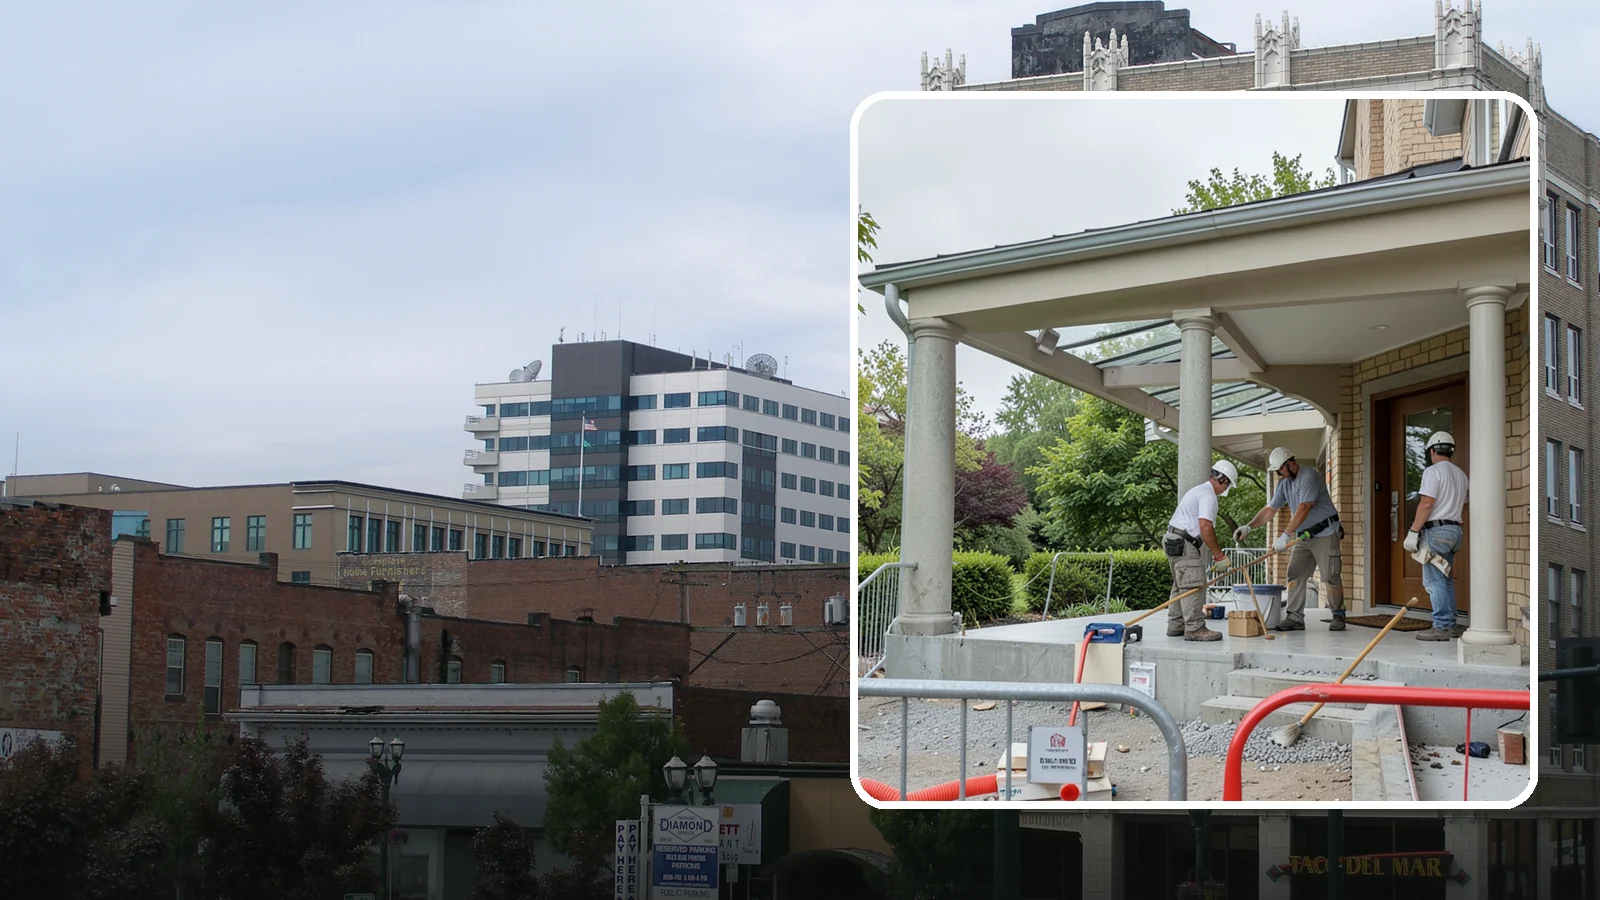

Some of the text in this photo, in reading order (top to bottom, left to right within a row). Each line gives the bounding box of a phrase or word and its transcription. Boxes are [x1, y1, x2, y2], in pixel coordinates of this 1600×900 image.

[343, 566, 427, 577] Home Furnishers
[660, 818, 713, 832] DIAMOND
[1022, 815, 1070, 828] BUILDING
[719, 824, 740, 835] ETT
[656, 845, 716, 854] RESERVED PARKING
[616, 825, 625, 893] PAY HERE
[627, 825, 637, 893] PAY HERE
[722, 852, 738, 862] Soup
[671, 862, 701, 870] PATRONS
[1346, 856, 1385, 875] DEL
[1392, 857, 1442, 877] MAR
[660, 888, 710, 898] PUBLIC PARKING
